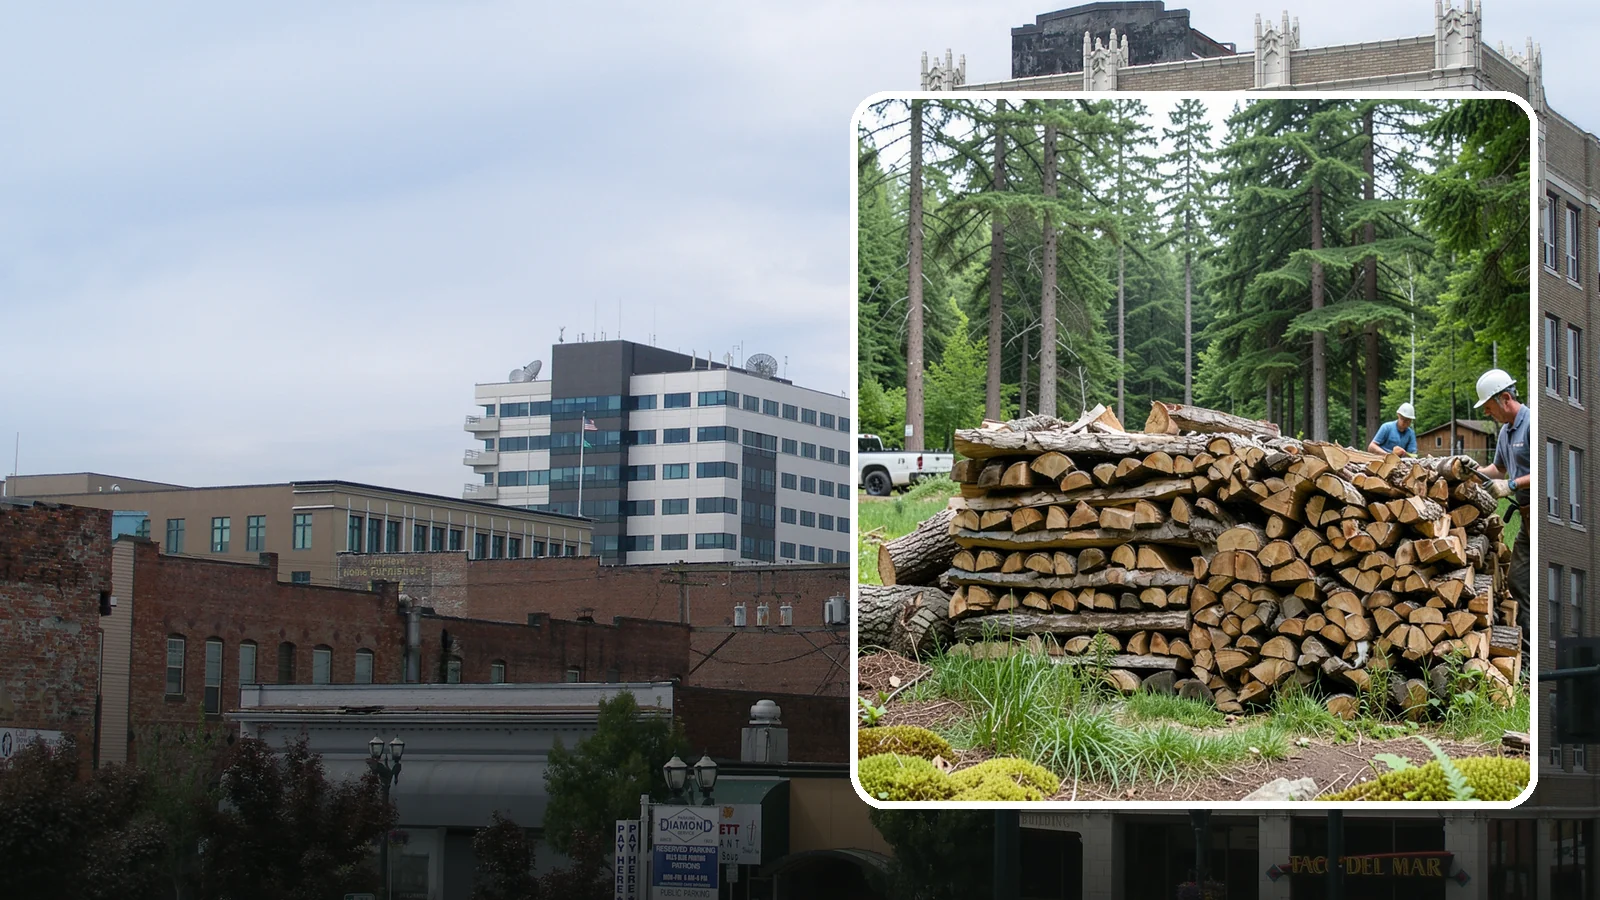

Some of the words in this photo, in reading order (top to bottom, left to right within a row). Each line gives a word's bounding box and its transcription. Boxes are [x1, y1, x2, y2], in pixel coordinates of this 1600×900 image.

[370, 566, 427, 577] Furnishers
[1022, 815, 1070, 828] BUILDING
[617, 825, 625, 853] PAY
[628, 825, 637, 853] PAY
[656, 845, 688, 853] RESERVED
[689, 846, 716, 854] PARKING
[721, 851, 739, 862] Soup
[671, 862, 701, 870] PATRONS
[1289, 855, 1330, 874] TAC
[1346, 856, 1385, 876] DEL
[1392, 857, 1442, 877] MAR
[616, 856, 625, 894] HERE
[627, 856, 636, 894] HERE
[660, 889, 682, 897] PUBLIC
[683, 890, 710, 898] PARKING
